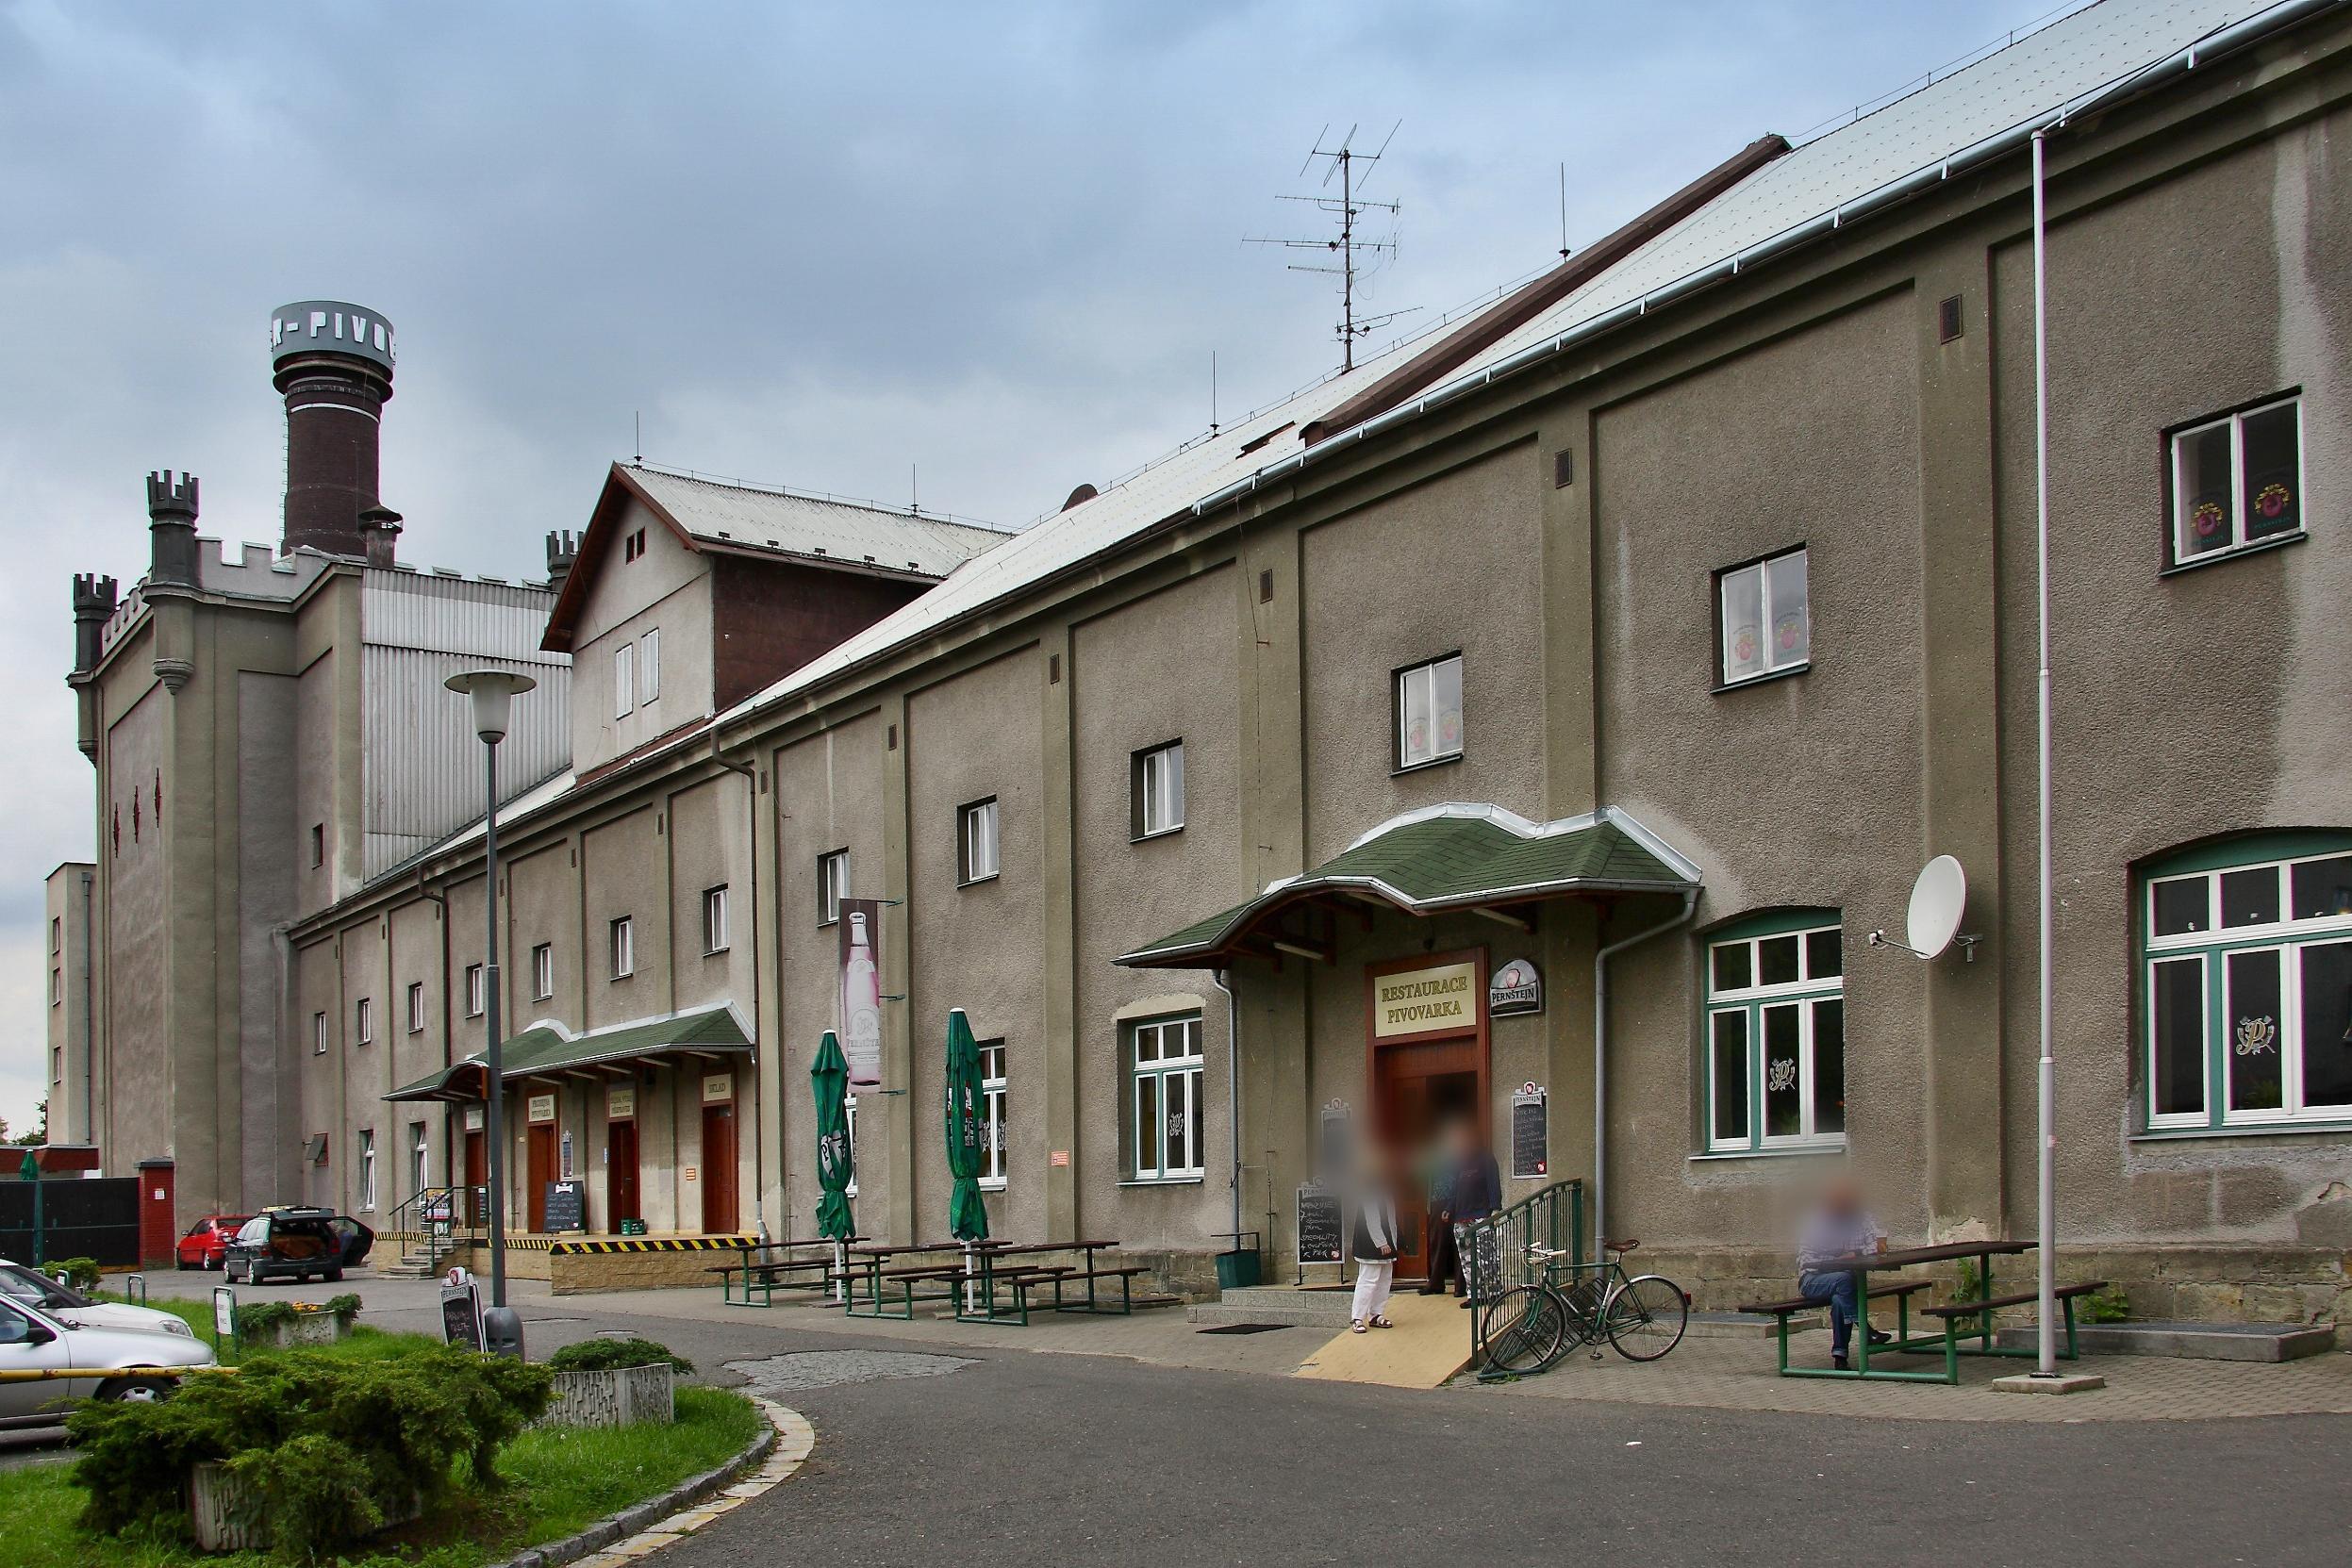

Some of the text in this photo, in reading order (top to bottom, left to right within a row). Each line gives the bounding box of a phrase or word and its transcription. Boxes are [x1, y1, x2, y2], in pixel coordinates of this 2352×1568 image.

[1382, 976, 1467, 1002] RESTAURACE
[1491, 987, 1535, 1003] PERNŠTEJN
[1387, 1000, 1463, 1023] PIVOVARKA
[708, 1082, 726, 1094] SKLAD
